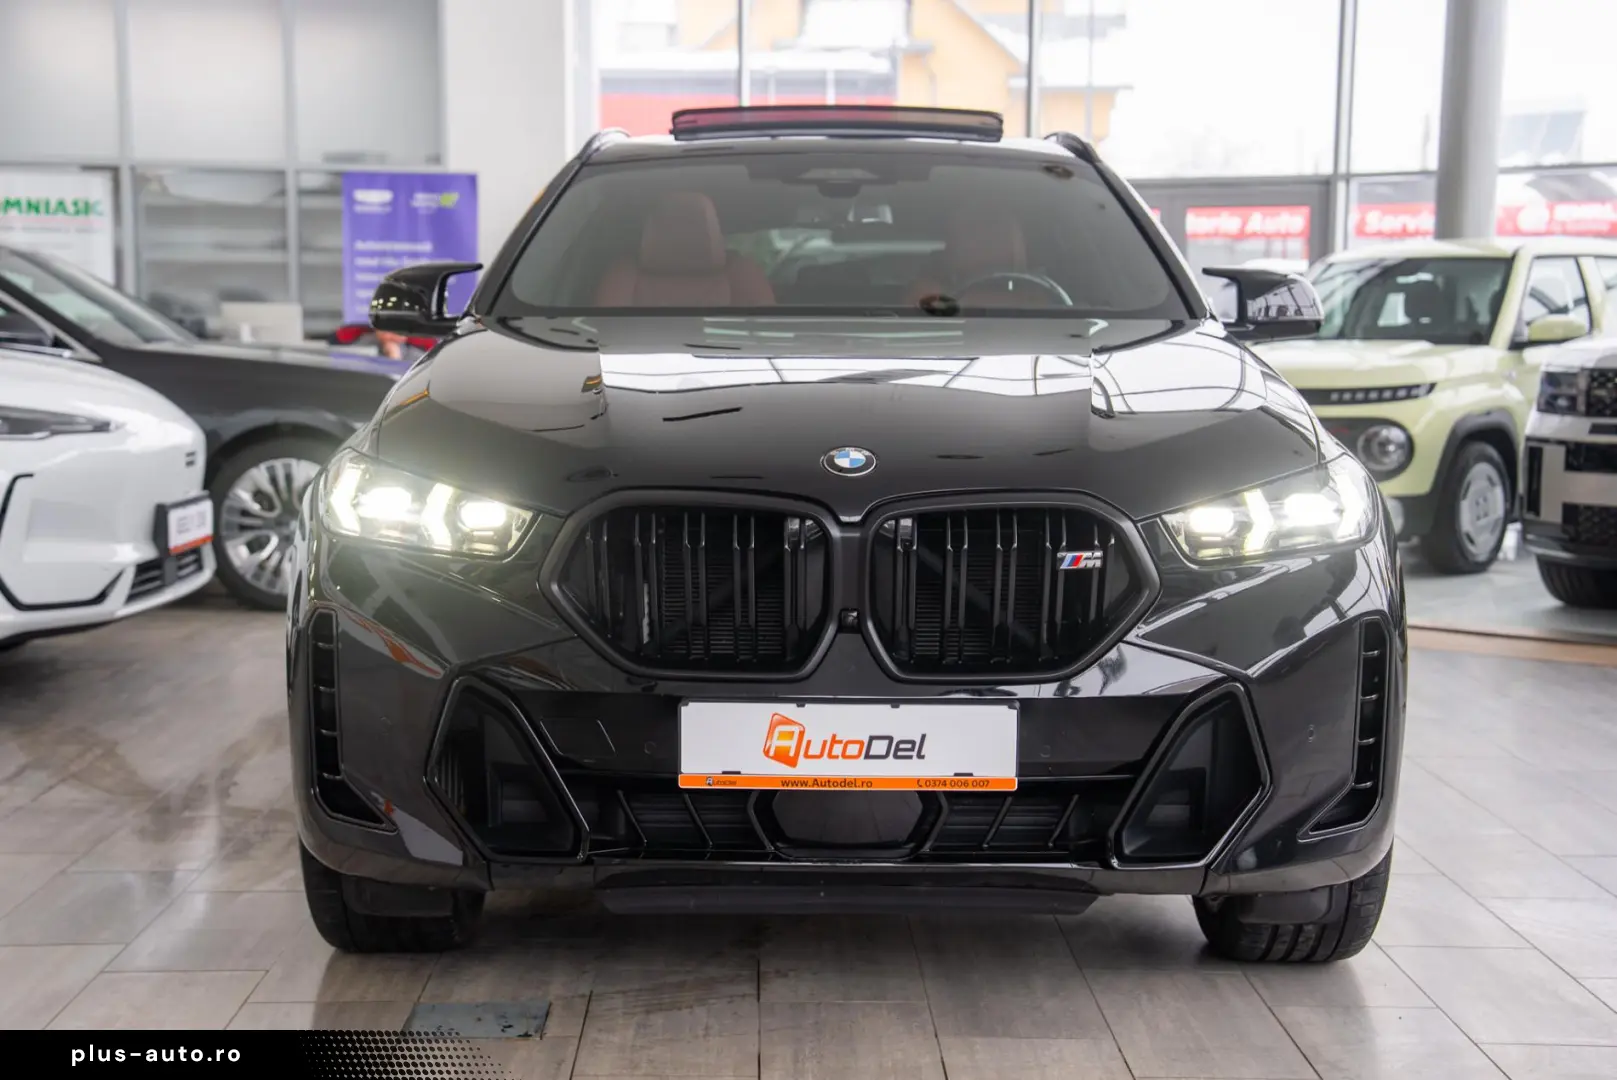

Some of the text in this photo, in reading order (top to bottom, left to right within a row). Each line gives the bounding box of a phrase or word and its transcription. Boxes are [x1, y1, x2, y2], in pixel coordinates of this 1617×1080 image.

[0, 196, 104, 216] MNIASI
[767, 723, 927, 760] AutoDel
[780, 778, 873, 789] www.Autodel.ro
[924, 779, 990, 788] 0374 006 007
